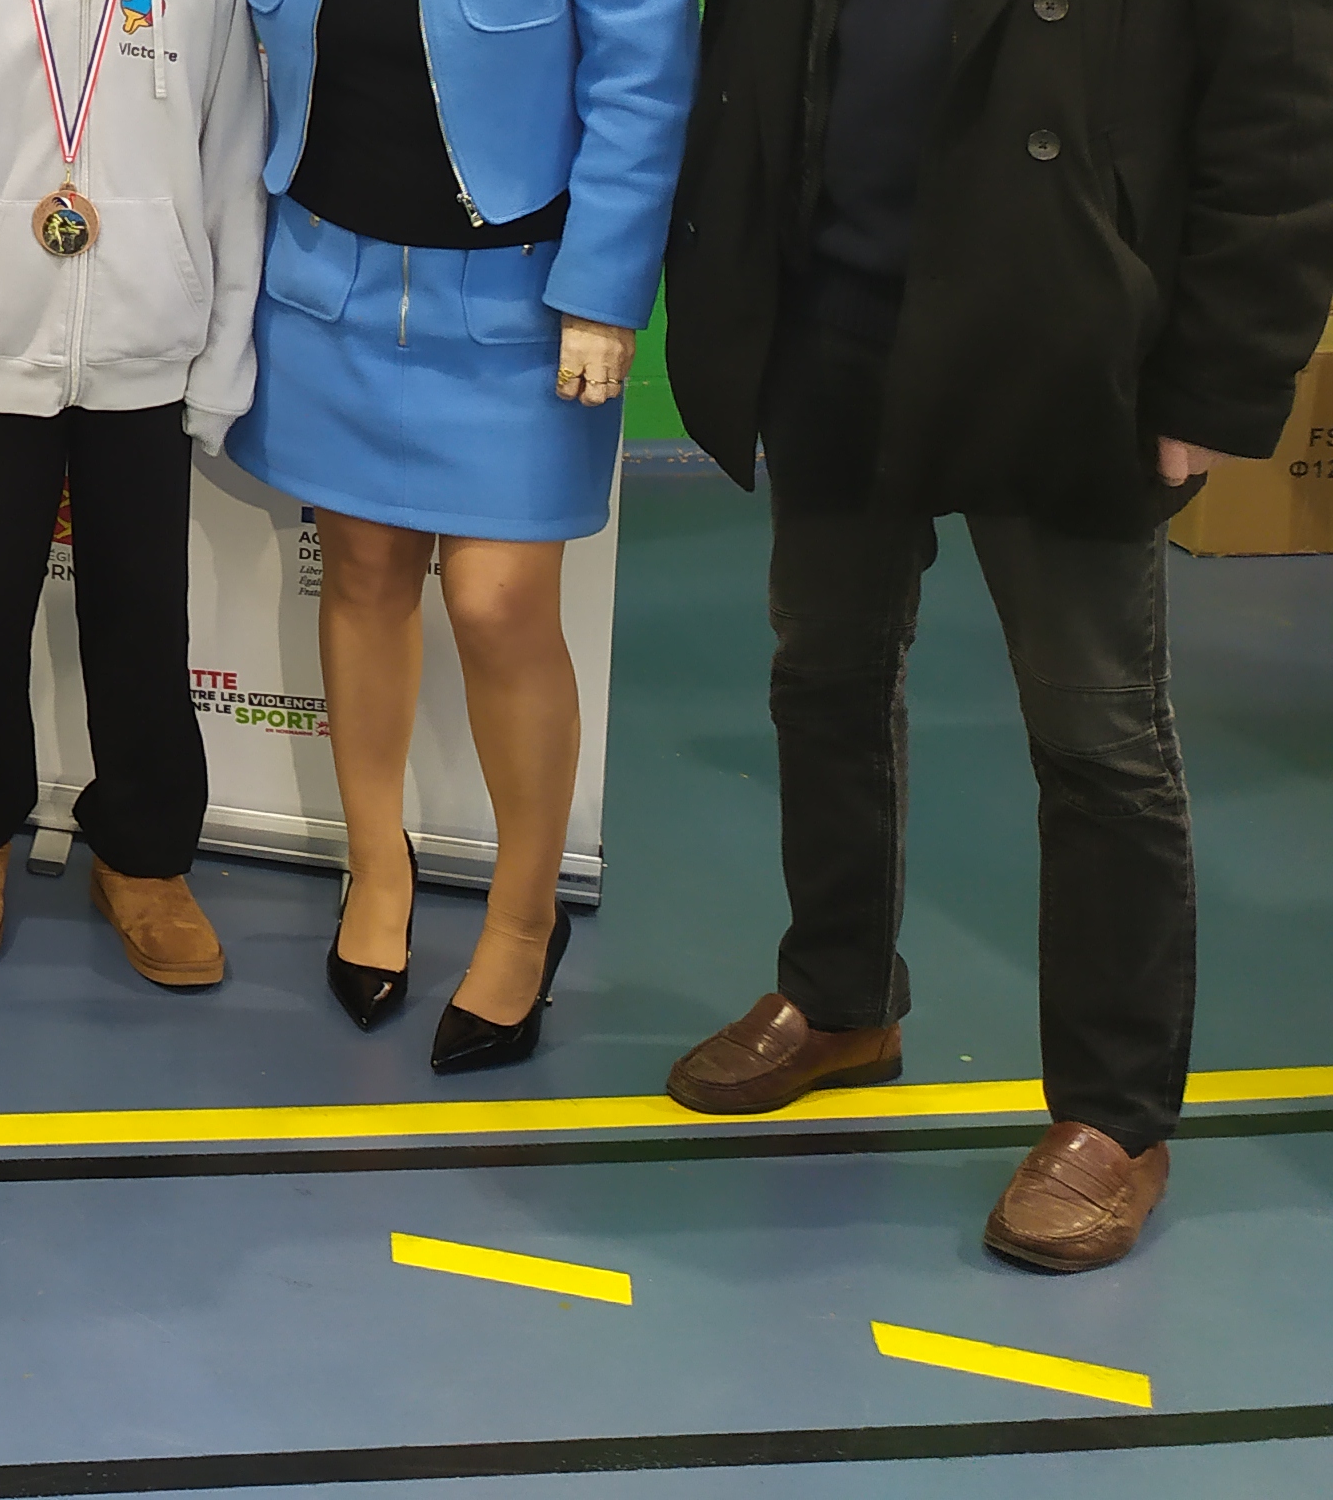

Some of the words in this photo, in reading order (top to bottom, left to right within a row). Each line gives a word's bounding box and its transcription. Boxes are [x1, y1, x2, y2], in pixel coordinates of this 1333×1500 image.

[119, 43, 177, 62] Victore
[220, 691, 246, 704] LES
[215, 703, 232, 714] LE
[235, 707, 317, 730] SPORT
